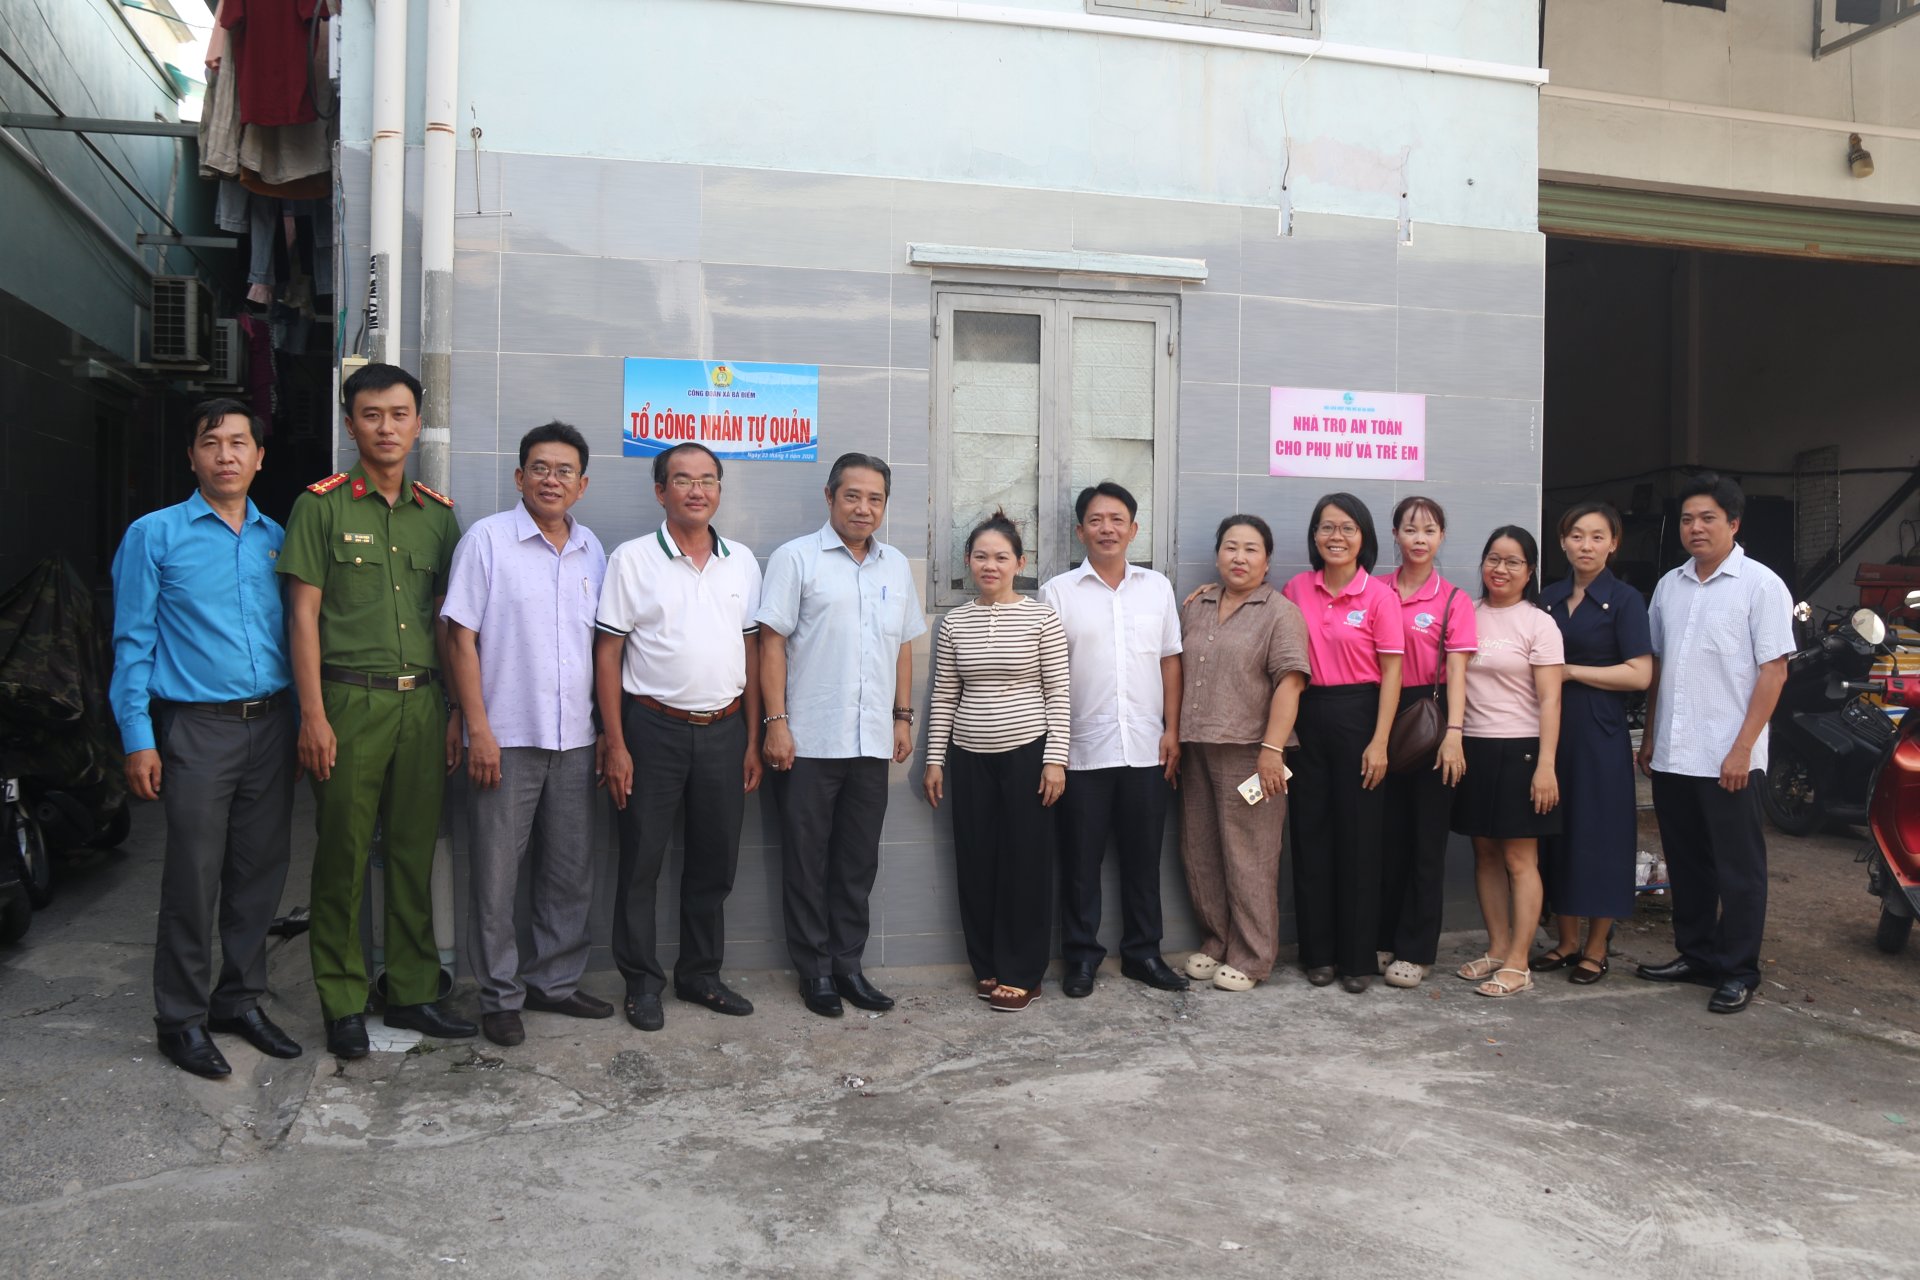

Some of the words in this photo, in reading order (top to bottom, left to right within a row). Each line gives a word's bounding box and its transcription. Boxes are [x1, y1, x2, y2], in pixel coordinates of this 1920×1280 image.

[631, 402, 650, 439] TỔ
[654, 408, 696, 440] CÔNG
[700, 409, 743, 442] NHÂN
[747, 413, 767, 448] TỰ
[769, 408, 811, 446] QUẢN
[1293, 414, 1319, 433] NHÀ
[1323, 417, 1347, 436] TRỌ
[1350, 419, 1367, 434] AN
[1371, 418, 1403, 436] TOÀN
[1275, 440, 1302, 456] CHO
[1306, 441, 1331, 460] PHỤ
[1335, 441, 1354, 458] NỮ
[1356, 441, 1372, 459] VÀ
[1376, 441, 1397, 460] TRẺ
[1401, 445, 1418, 460] EM
